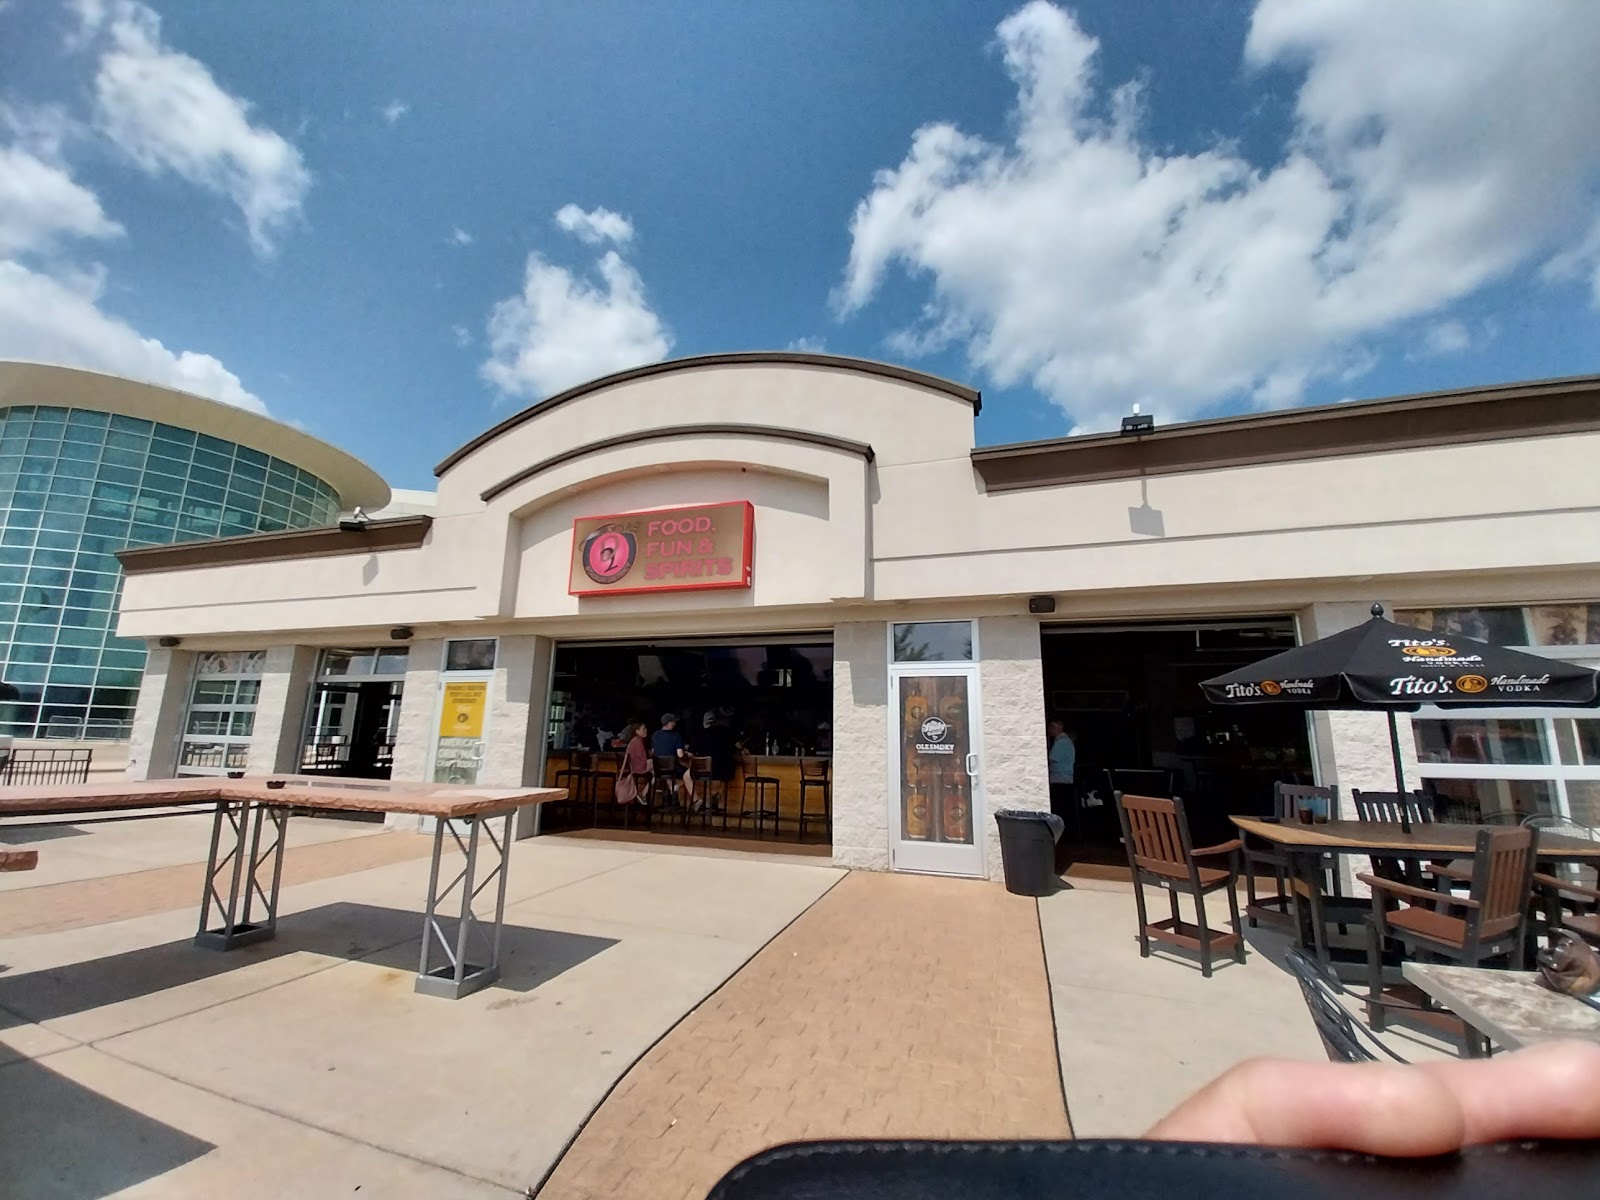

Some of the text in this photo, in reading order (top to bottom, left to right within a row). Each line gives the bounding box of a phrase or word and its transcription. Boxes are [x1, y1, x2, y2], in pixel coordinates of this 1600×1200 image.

[646, 537, 714, 558] FUN &
[644, 557, 733, 580] SPIRITS
[1280, 679, 1314, 688] Handmade
[1490, 674, 1550, 685] Handmade
